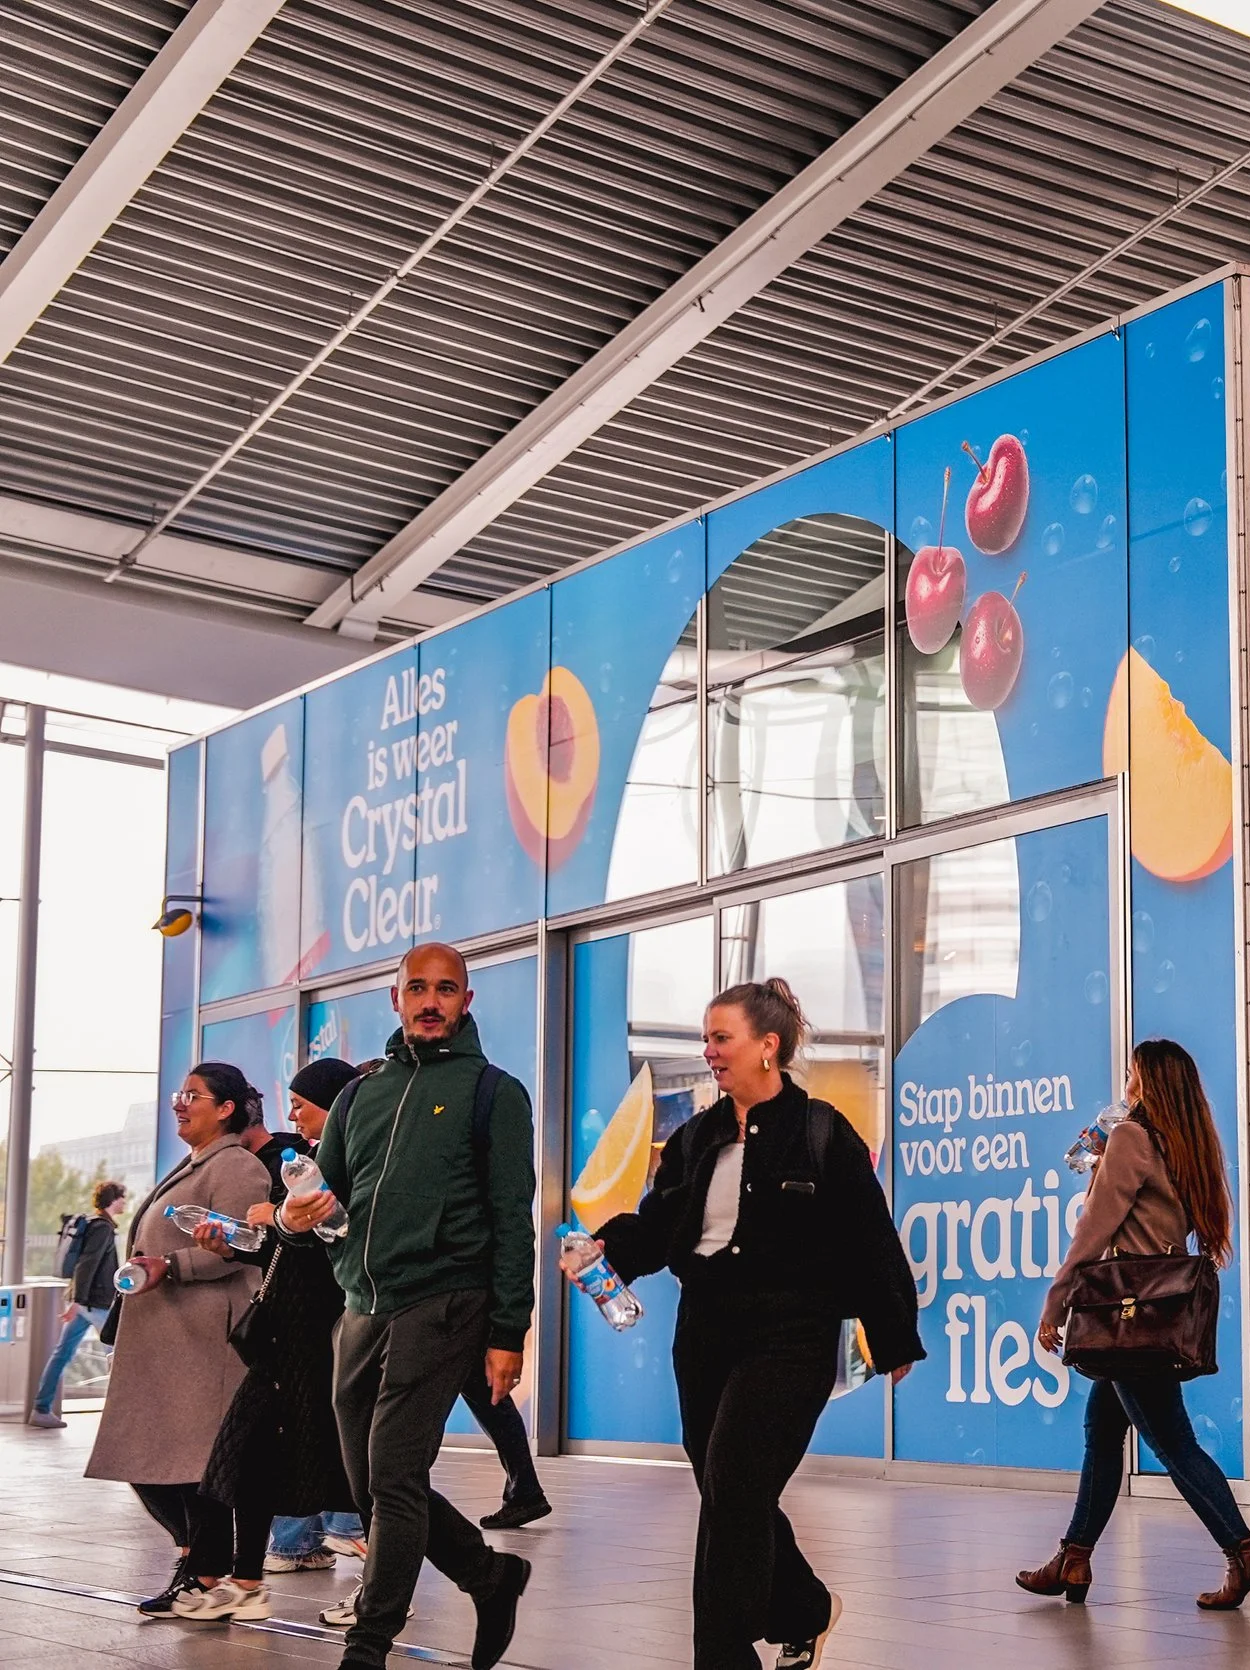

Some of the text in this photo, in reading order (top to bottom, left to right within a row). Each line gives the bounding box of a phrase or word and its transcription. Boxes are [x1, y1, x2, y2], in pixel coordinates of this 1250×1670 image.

[380, 667, 447, 731] Alles
[367, 720, 458, 790] is weer
[341, 758, 468, 875] Crystal
[899, 1073, 1075, 1133] Stap binnen
[899, 1131, 1030, 1177] voor een
[945, 1292, 1071, 1408] fles
